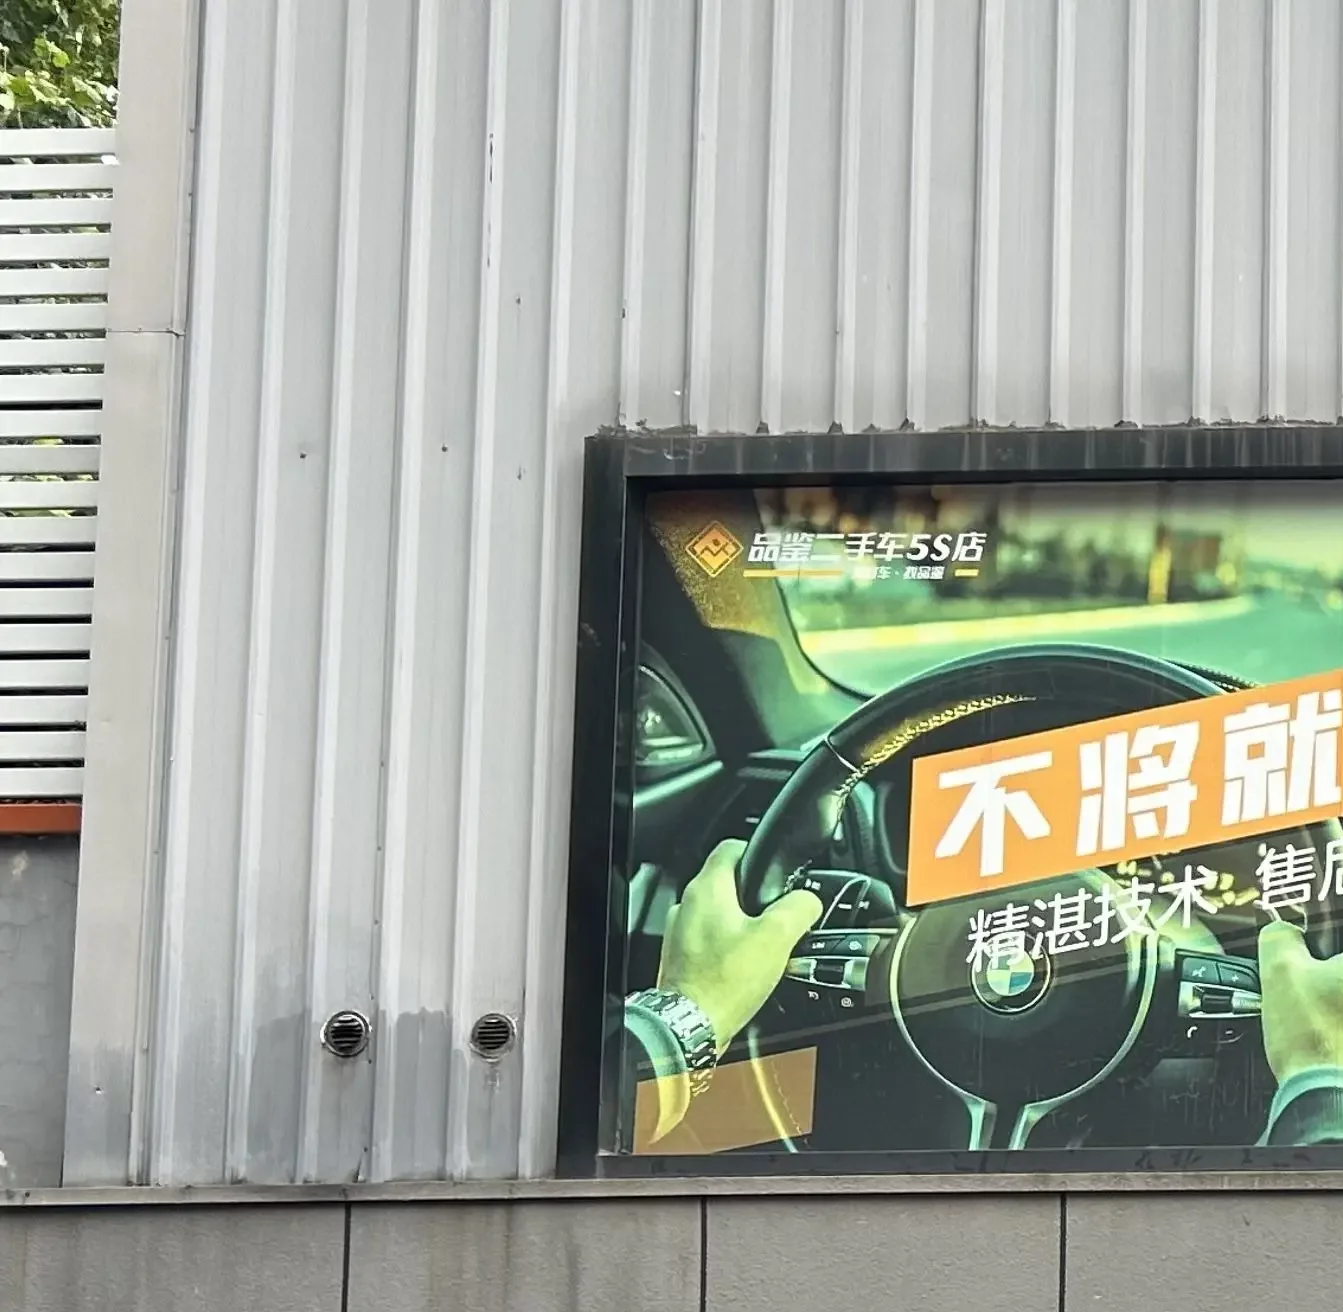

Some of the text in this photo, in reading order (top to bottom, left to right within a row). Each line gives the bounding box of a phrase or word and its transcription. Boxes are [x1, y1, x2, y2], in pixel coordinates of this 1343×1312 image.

[747, 532, 988, 562] 品鉴二手车5S店
[934, 689, 1343, 877] 不将就
[966, 864, 1218, 971] 精湛技术
